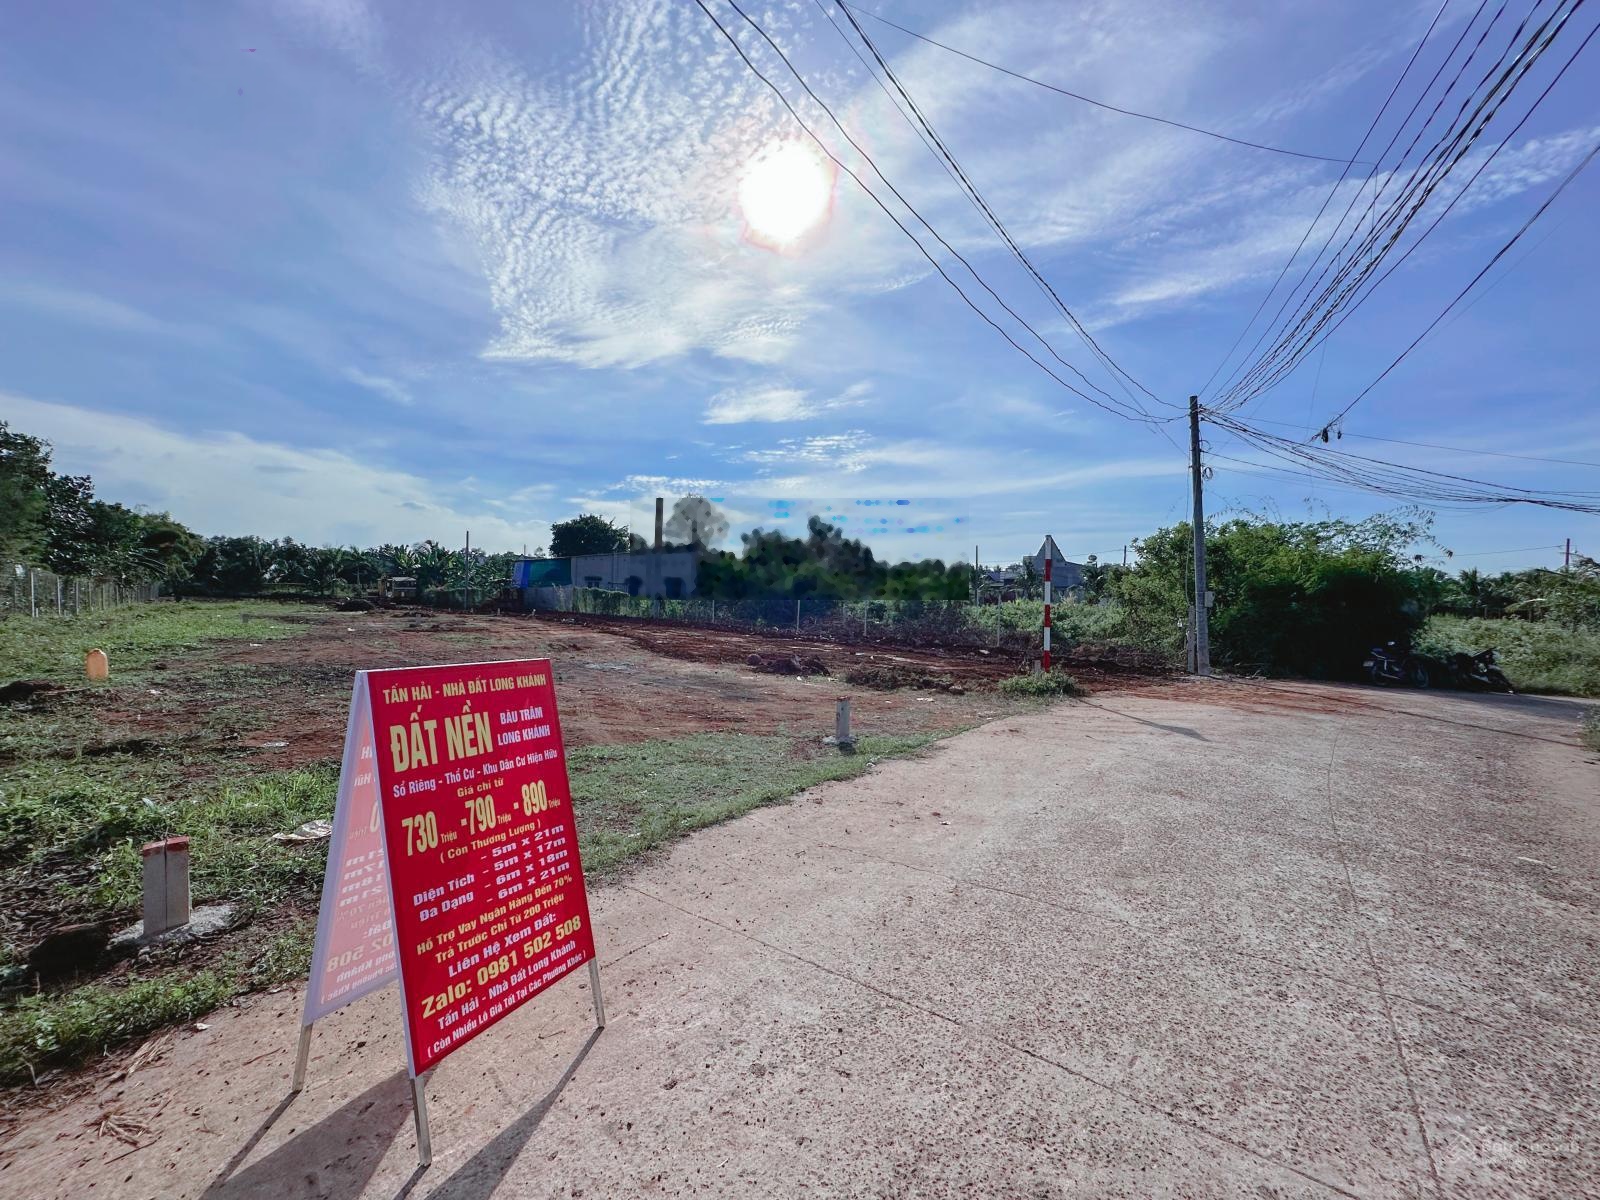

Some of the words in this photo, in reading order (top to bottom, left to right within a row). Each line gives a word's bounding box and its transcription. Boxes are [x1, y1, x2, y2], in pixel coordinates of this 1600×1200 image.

[383, 683, 408, 704] TẤN
[412, 682, 432, 700] HẢI
[443, 680, 465, 697] NHÀ
[468, 675, 487, 694] ĐẤT
[490, 677, 514, 692] LONG
[516, 673, 546, 688] KHÁNH
[390, 704, 438, 772] ĐẤT
[444, 700, 493, 760] NỀN
[497, 732, 520, 746] LONG
[522, 724, 550, 740] KHÁNH
[393, 780, 406, 798] Sổ
[409, 778, 436, 794] Riêng
[445, 768, 460, 784] Thổ
[464, 769, 475, 780] Cư
[483, 763, 498, 775] Khu
[500, 758, 514, 771] Dân
[516, 755, 526, 768] Cư
[527, 752, 543, 766] Hiện
[457, 786, 474, 798] Giá
[494, 778, 504, 788] từ
[402, 811, 438, 856] 730
[441, 831, 457, 844] Triệu
[498, 813, 511, 826] Triệu
[521, 779, 547, 816] 890
[448, 846, 468, 859] Còn
[470, 834, 506, 851] Thương
[509, 821, 535, 837] Lượng
[492, 842, 517, 858] 5m
[522, 838, 530, 846] x
[534, 824, 564, 841] 21m
[494, 856, 518, 871] 5m
[523, 851, 532, 859] x
[537, 837, 566, 854] 17m
[496, 870, 521, 885] 6m
[525, 864, 534, 872] x
[539, 850, 568, 866] 18m
[498, 883, 523, 900] 6m
[527, 877, 536, 886] x
[540, 862, 570, 880] 21m
[413, 886, 444, 906] Diện
[448, 873, 475, 892] Tích
[420, 907, 438, 922] Đa
[442, 892, 474, 912] Dạng
[435, 946, 454, 964] Trả
[457, 932, 488, 952] Trước
[524, 904, 540, 919] 200
[542, 893, 564, 910] Triệu
[436, 930, 455, 945] Trợ
[458, 920, 476, 935] Vay
[480, 904, 506, 925] Ngân
[508, 893, 532, 910] Hàng
[534, 884, 552, 898] Đến
[553, 875, 572, 890] 70%
[448, 953, 480, 977] Liên
[483, 941, 500, 960] Hệ
[504, 926, 531, 947] Xem
[534, 912, 557, 930] Đất:
[422, 980, 472, 1019] Zalo:
[477, 950, 518, 986] 0981
[523, 931, 552, 959] 502
[555, 915, 582, 940] 508
[438, 1008, 458, 1030] Tấn
[461, 996, 479, 1017] Hải
[488, 980, 508, 1001] Nhà
[510, 968, 527, 986] Đất
[528, 954, 549, 976] Long
[550, 940, 576, 962] Khánh
[434, 1034, 451, 1053] Còn
[478, 1011, 488, 1025] Lô
[503, 992, 516, 1009] Tốt
[516, 985, 528, 1002] Tại
[528, 977, 542, 993] Các
